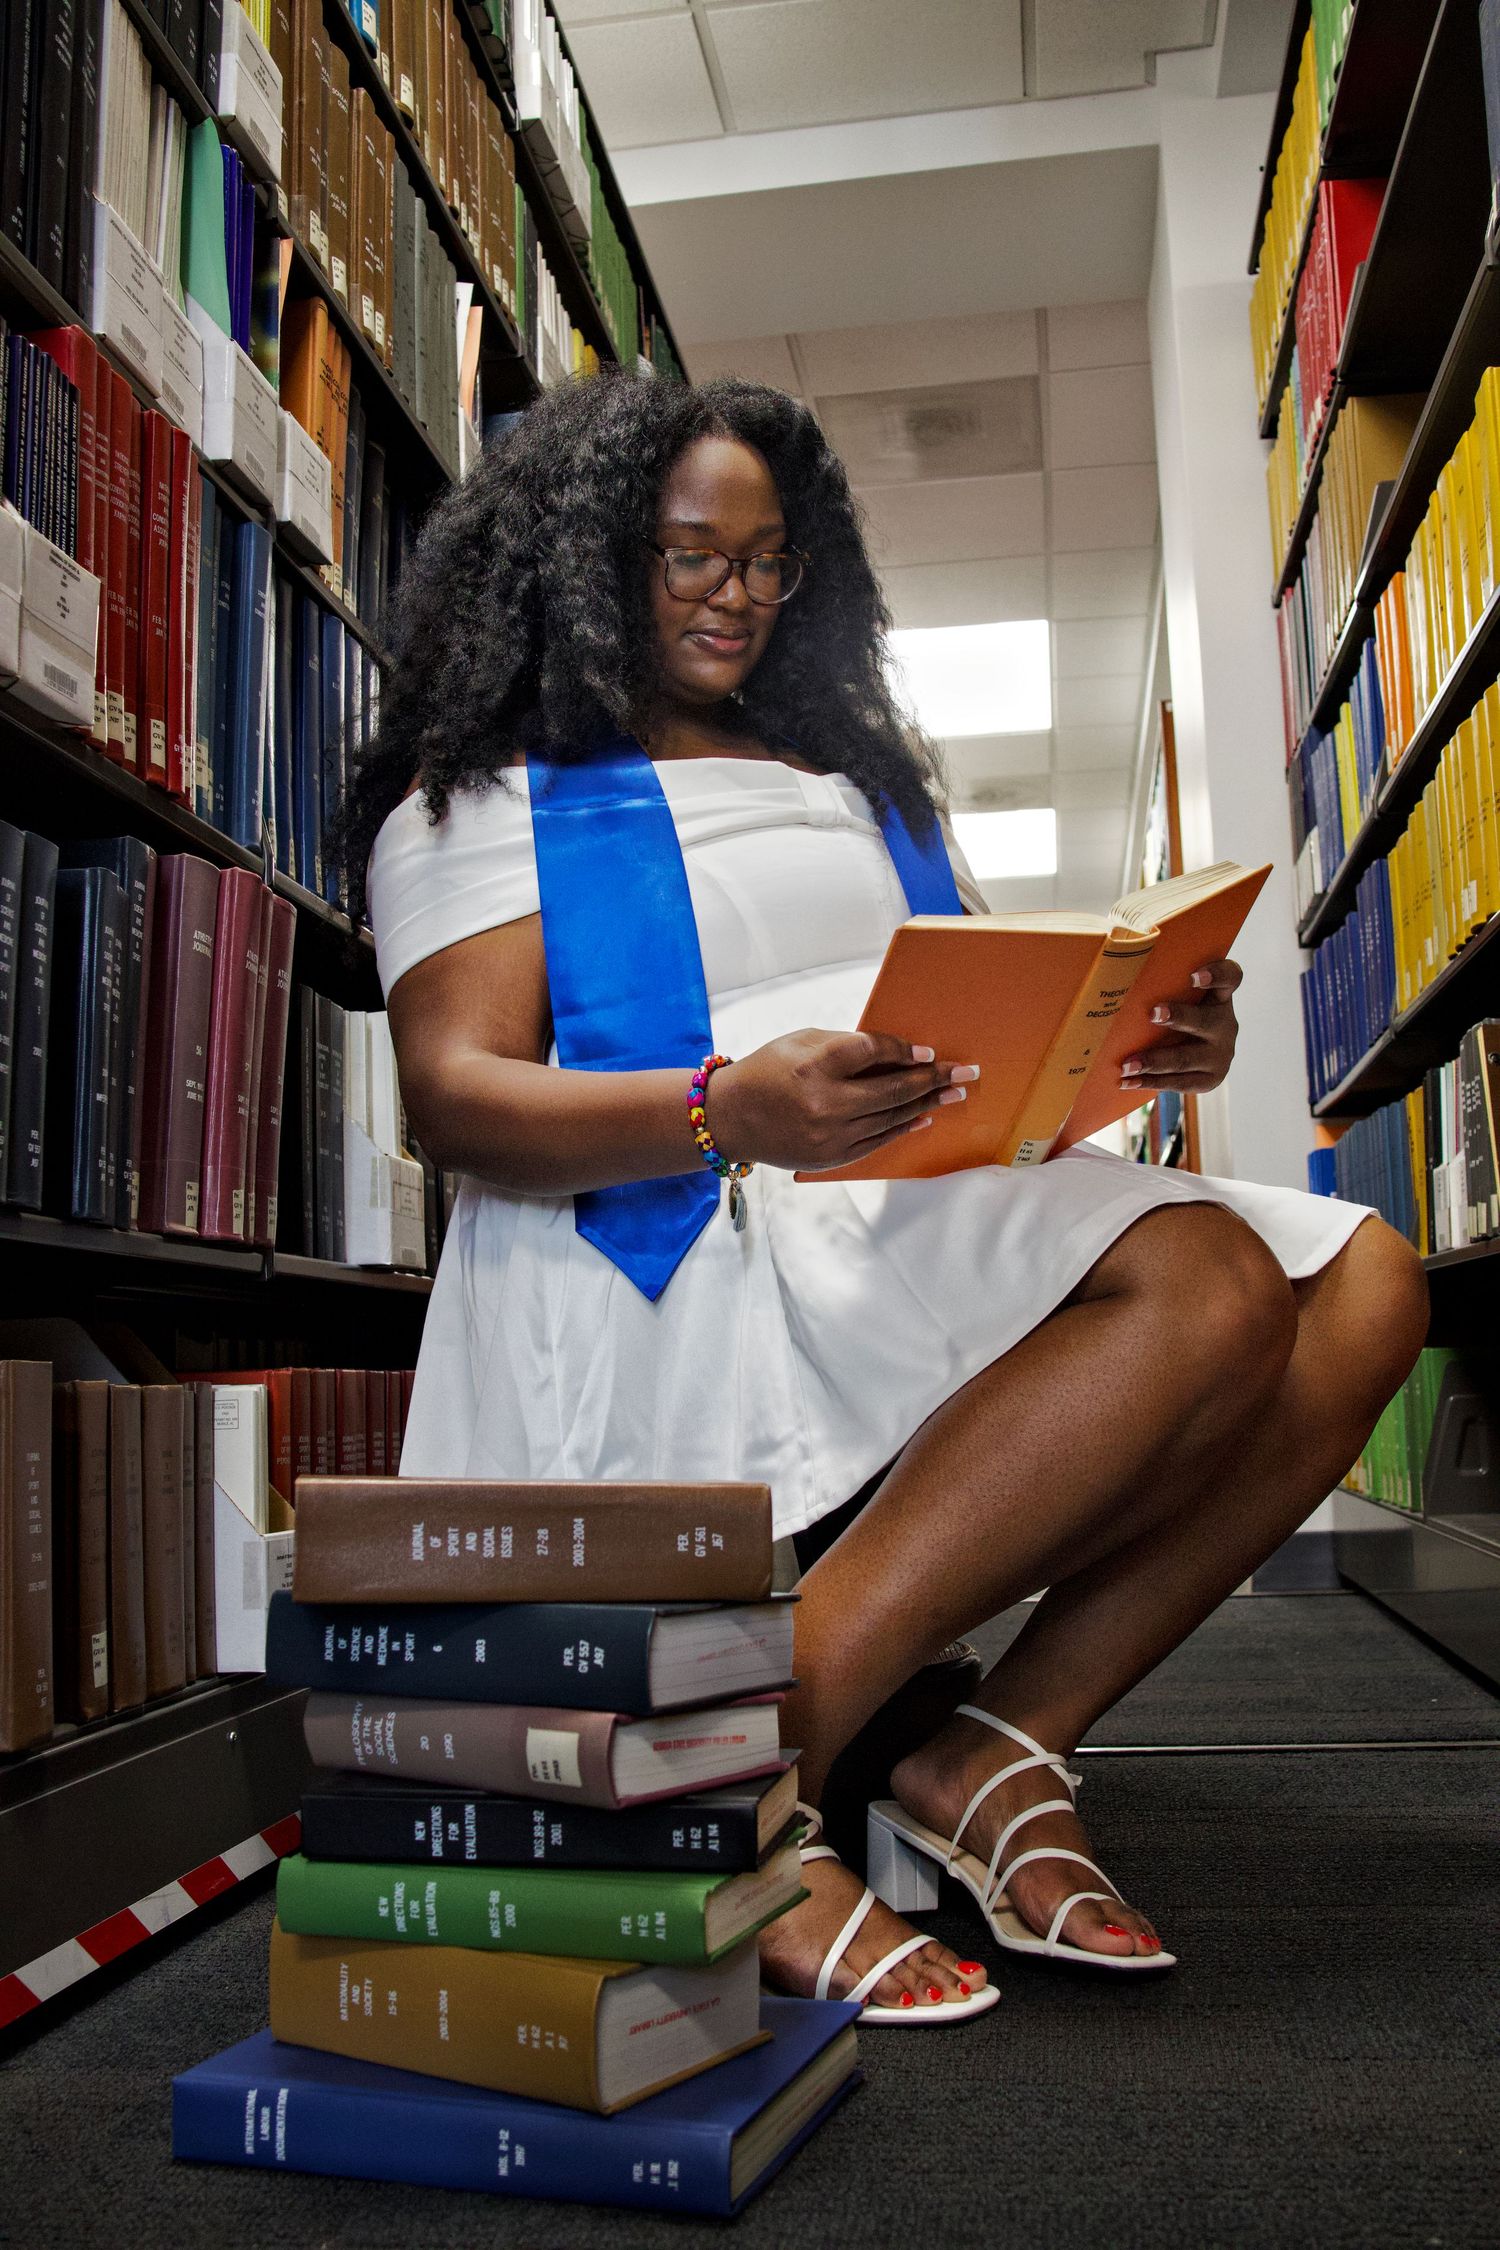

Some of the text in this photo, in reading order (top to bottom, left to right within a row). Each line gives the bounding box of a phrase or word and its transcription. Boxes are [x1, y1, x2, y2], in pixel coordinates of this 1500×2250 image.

[1104, 1000, 1118, 1008] and
[1084, 1048, 1090, 1056] 6
[1068, 1066, 1086, 1075] 1975
[412, 1520, 424, 1562] JOURNAL
[430, 1536, 442, 1548] OF
[448, 1527, 460, 1557] SPORT
[465, 1531, 478, 1552] AND
[482, 1526, 496, 1558] SOCIAL
[500, 1526, 513, 1558] ISSUES
[536, 1528, 548, 1556] 27-28
[572, 1517, 586, 1568] 2003-2004
[678, 1532, 689, 1552] PER.
[694, 1526, 706, 1558] GV 561
[324, 1623, 335, 1663] JOURNAL
[338, 1638, 348, 1650] OF
[350, 1626, 362, 1663] SCIENCE
[364, 1635, 374, 1654] AND
[377, 1625, 390, 1666] MEDICINE
[392, 1641, 401, 1652] IN
[404, 1632, 416, 1663] SPORT
[432, 1644, 443, 1653] 6
[475, 1638, 486, 1664] 2003
[563, 1646, 574, 1667] PER.
[578, 1639, 590, 1674] GV 557
[352, 1700, 367, 1766] PHILOSOPHY
[362, 1716, 374, 1756] OF THE
[374, 1717, 386, 1757] SOCIAL
[385, 1711, 398, 1766] SCIENCES
[420, 1735, 430, 1752] 20
[444, 1733, 455, 1760] 1990
[414, 1820, 426, 1842] NEW
[430, 1804, 444, 1858] DIRECTIONS
[448, 1820, 460, 1842] FOR
[464, 1804, 478, 1860] EVALUATION
[551, 1823, 563, 1846] 2001
[672, 1827, 685, 1848] PER.
[690, 1826, 702, 1850] H 62
[378, 1896, 390, 1918] NEW
[394, 1882, 408, 1933] DIRECTIONS
[409, 1899, 420, 1920] FOR
[426, 1882, 438, 1937] EVALUATION
[504, 1904, 517, 1928] 2000
[638, 1914, 649, 1938] H 62
[340, 1962, 350, 2022] RATIONALITY
[352, 1984, 361, 2004] AND
[364, 1978, 373, 2016] SOCIETY
[388, 1990, 398, 2016] 15-16
[439, 1989, 450, 2042] 2003-2004
[628, 2018, 656, 2036] LIBRARY
[656, 2005, 692, 2026] UNIVERSITY
[532, 2025, 542, 2049] H 62
[245, 2088, 258, 2155] INTERNATIONAL
[260, 2106, 270, 2140] LABOUR
[276, 2088, 289, 2162] DOCUMENTATION
[498, 2154, 508, 2177] NOS.
